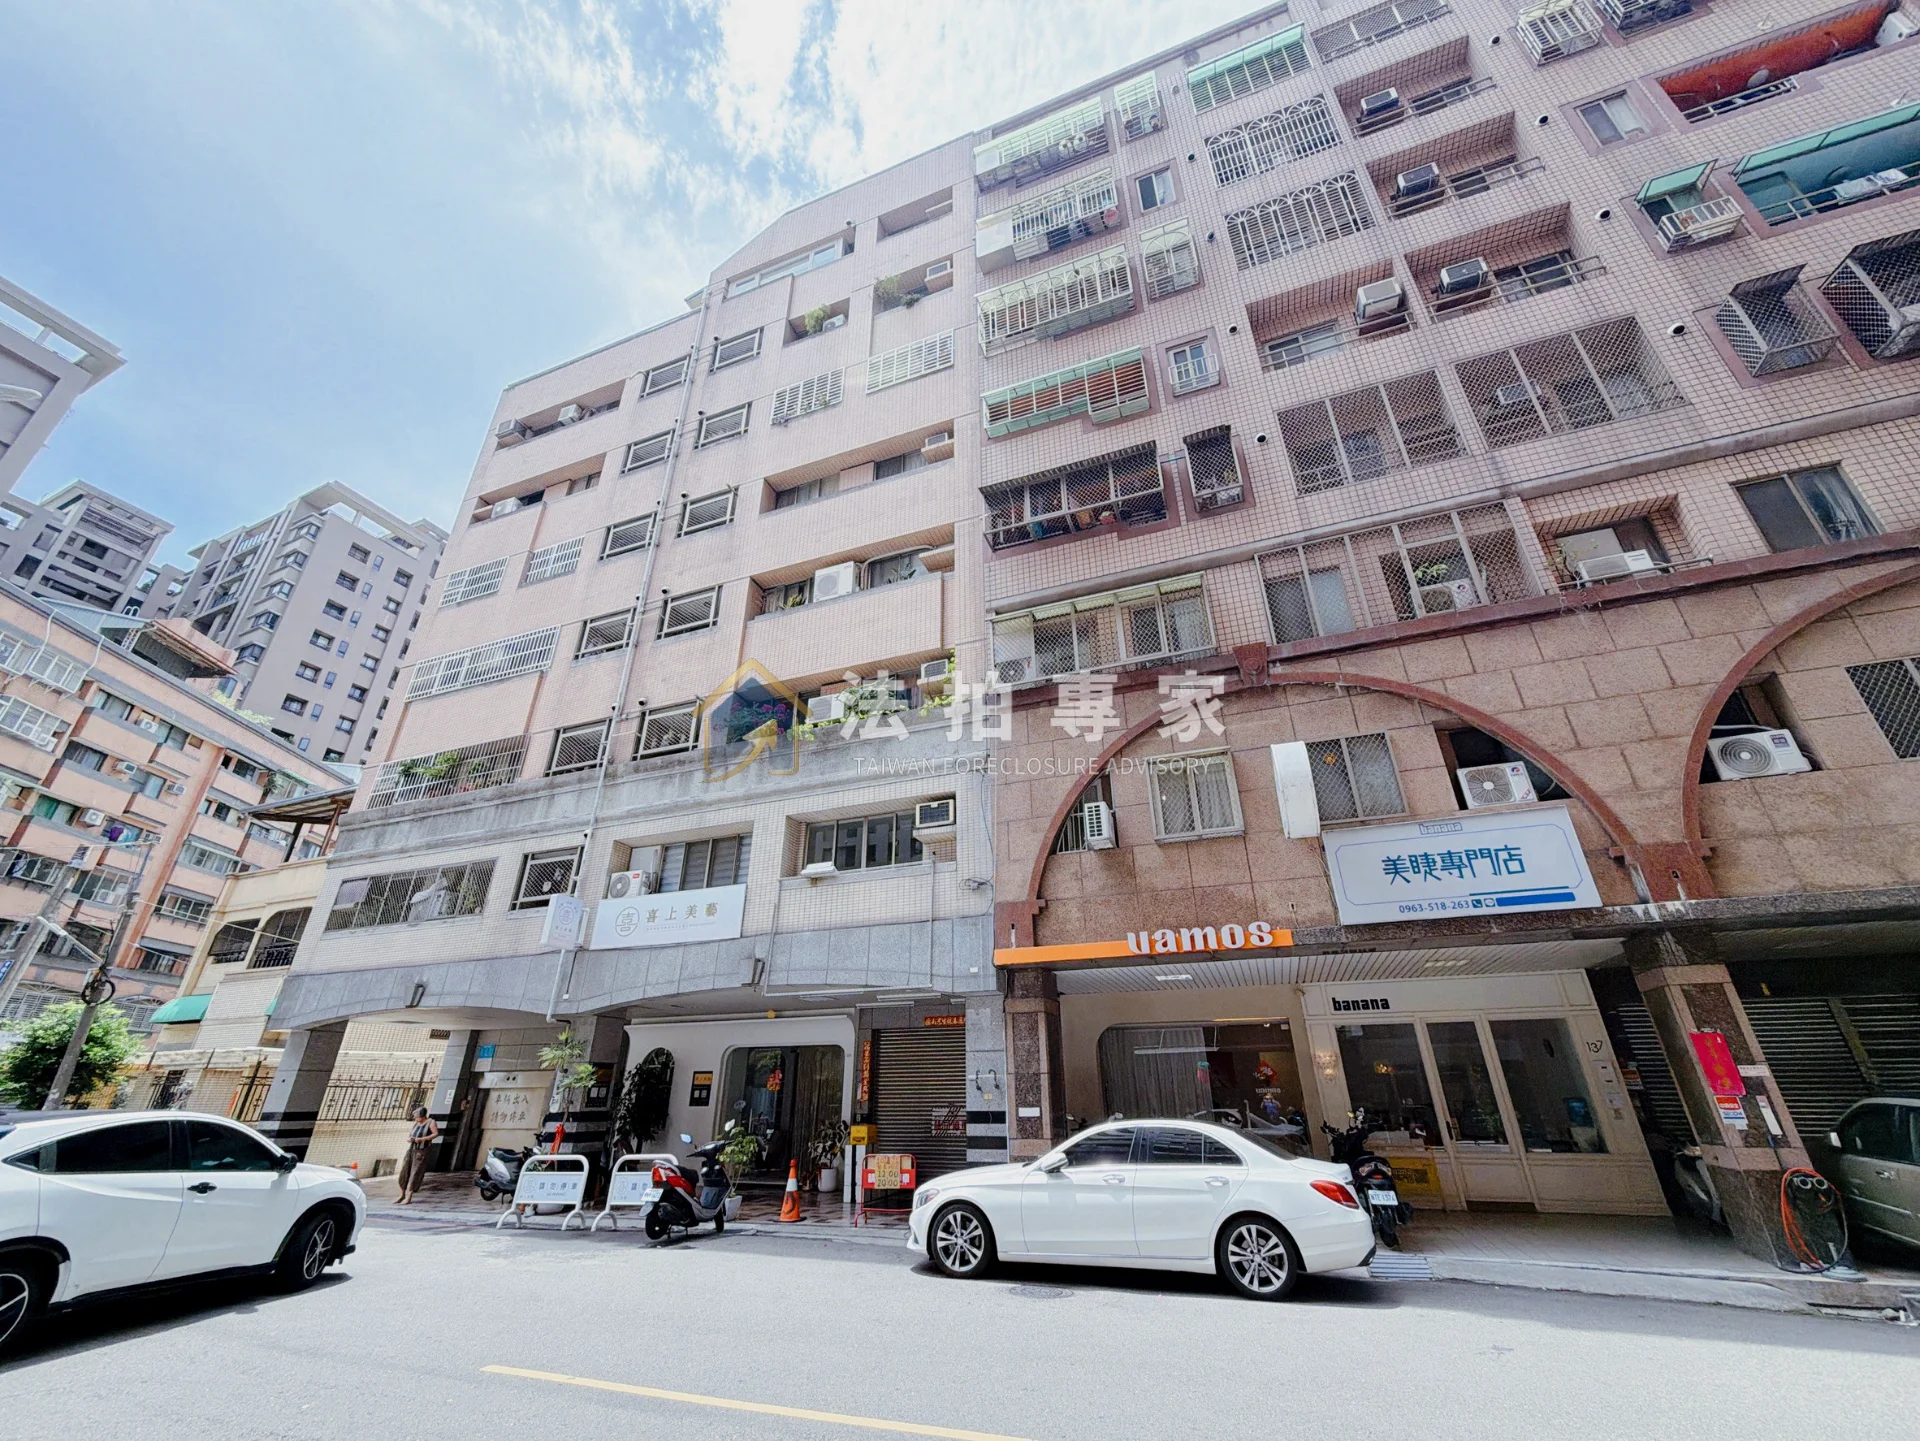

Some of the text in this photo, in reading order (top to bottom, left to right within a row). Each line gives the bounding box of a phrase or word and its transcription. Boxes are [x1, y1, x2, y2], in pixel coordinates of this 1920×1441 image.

[1418, 822, 1464, 836] banana
[1381, 844, 1526, 886] 美睫專門店
[645, 902, 719, 924] 喜上美藝
[1398, 899, 1471, 914] 0963-518-263
[1331, 996, 1391, 1012] banana
[1586, 1040, 1603, 1053] 137
